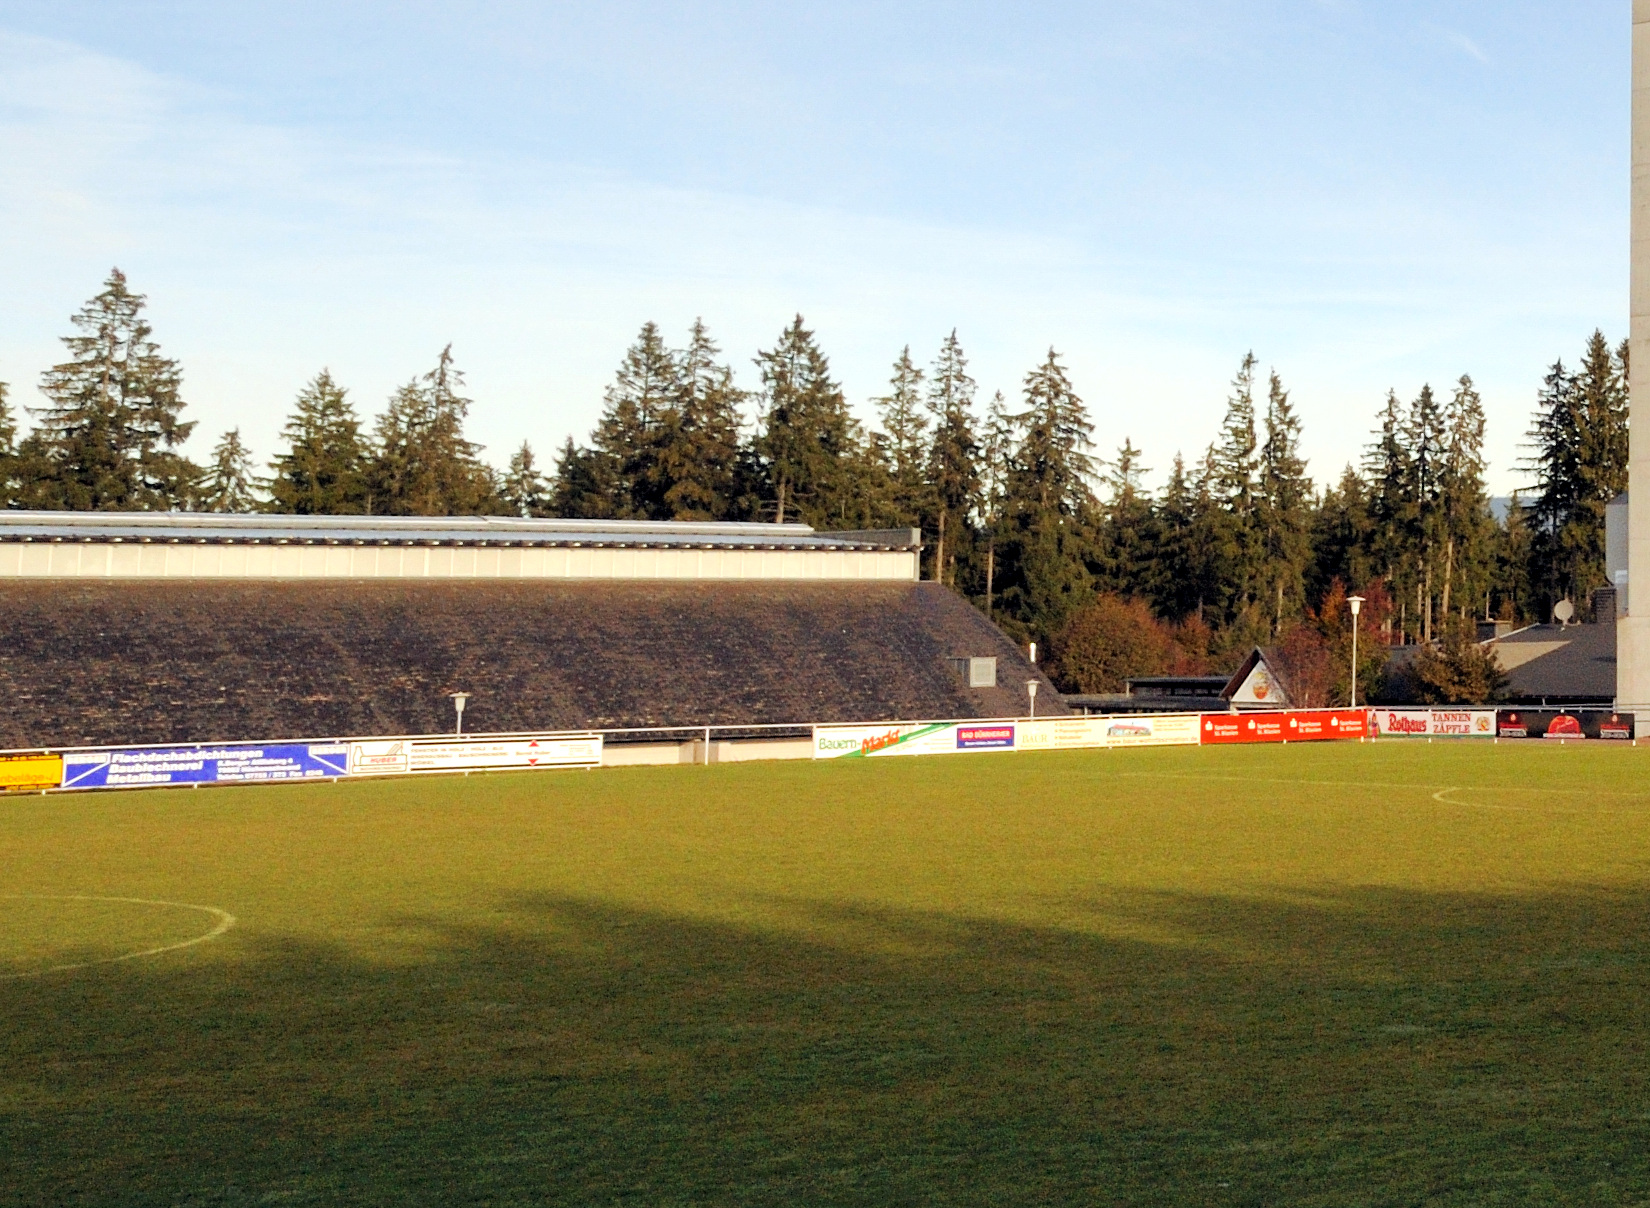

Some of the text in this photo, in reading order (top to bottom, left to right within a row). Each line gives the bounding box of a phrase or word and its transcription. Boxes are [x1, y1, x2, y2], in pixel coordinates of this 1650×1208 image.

[1388, 713, 1427, 735] Rothaus
[1431, 713, 1471, 722] TANNEN
[111, 749, 264, 764] Flachdachabdichtungen
